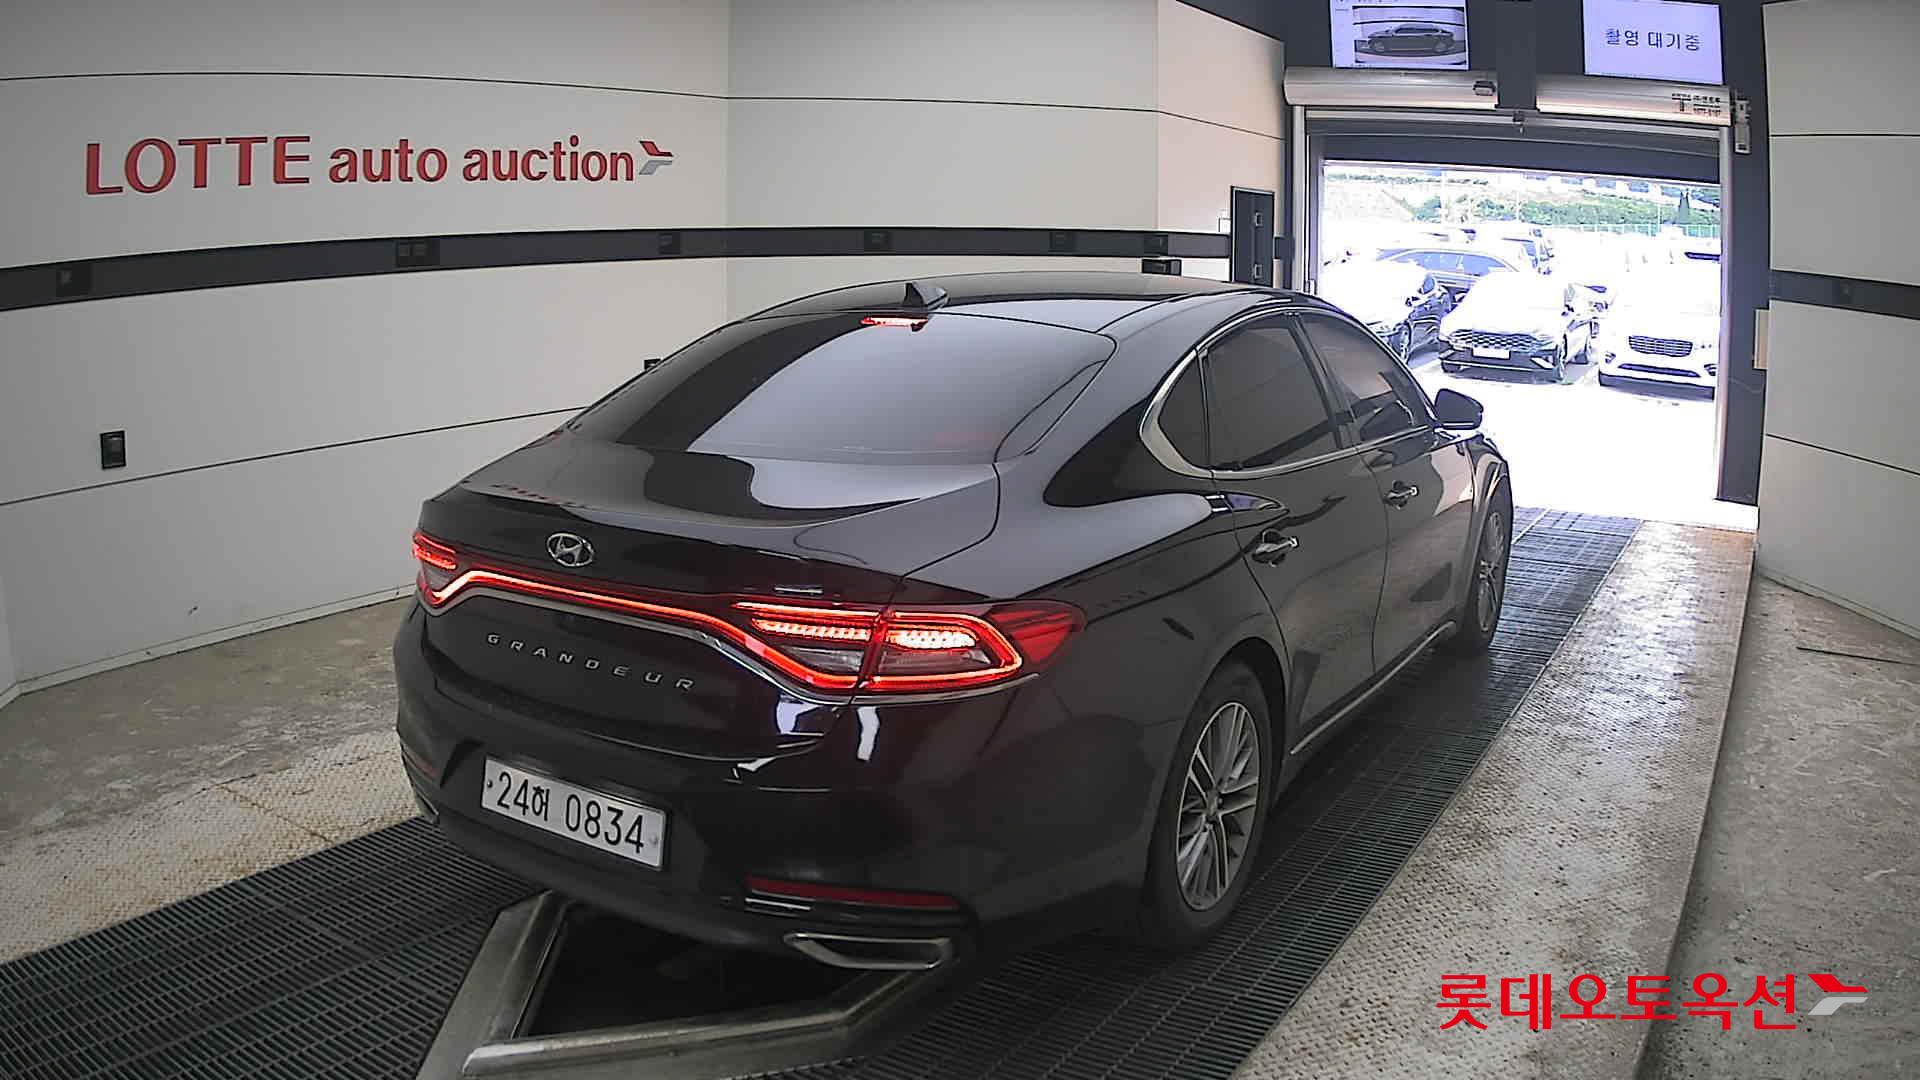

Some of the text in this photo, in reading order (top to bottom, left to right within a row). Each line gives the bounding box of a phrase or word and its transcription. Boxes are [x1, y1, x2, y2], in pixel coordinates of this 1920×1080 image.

[1606, 28, 1700, 51] 촬영 대기중
[86, 135, 634, 195] LOTTE auto auction
[486, 633, 695, 691] GRANDEUR
[497, 771, 644, 854] 24허 0834
